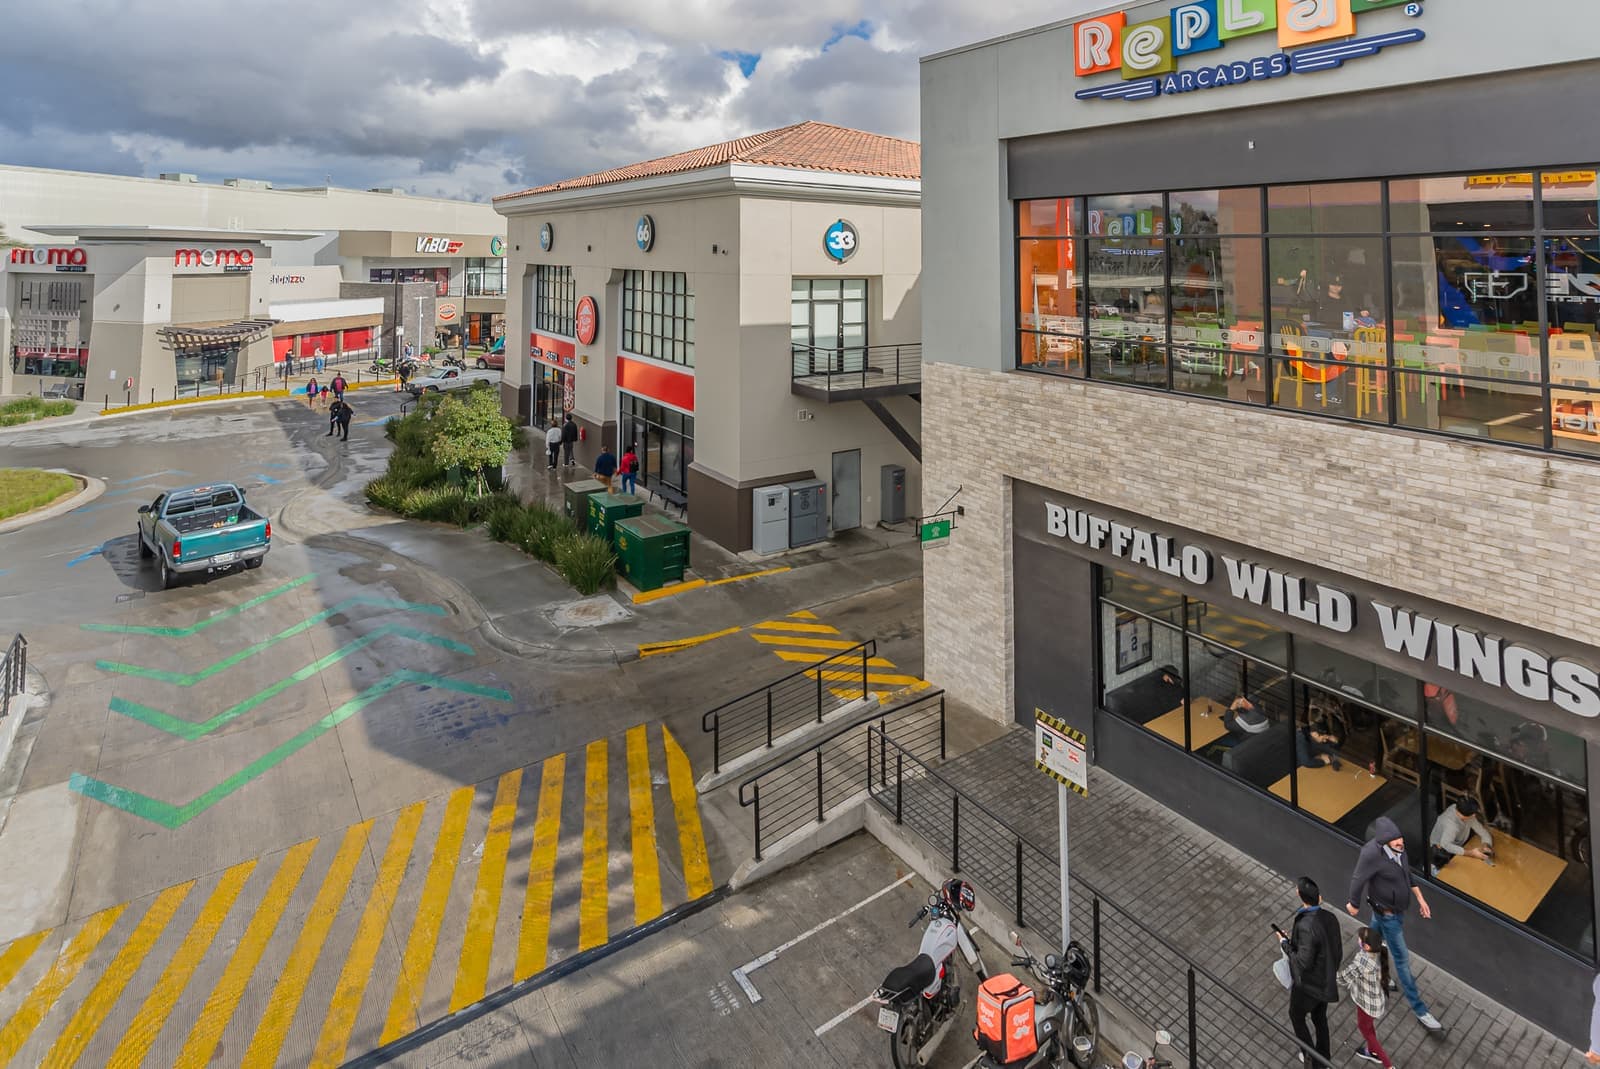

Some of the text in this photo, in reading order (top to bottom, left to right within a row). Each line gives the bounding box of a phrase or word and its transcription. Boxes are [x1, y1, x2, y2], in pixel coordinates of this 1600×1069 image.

[1078, 0, 1377, 70] RePLa
[1165, 56, 1284, 92] ARCADES
[637, 224, 650, 242] 66
[829, 231, 855, 250] 33
[11, 247, 87, 265] moma
[175, 249, 254, 266] moma
[1045, 502, 1600, 717] BUFFALO WILD WINGS
[1131, 636, 1138, 651] 2
